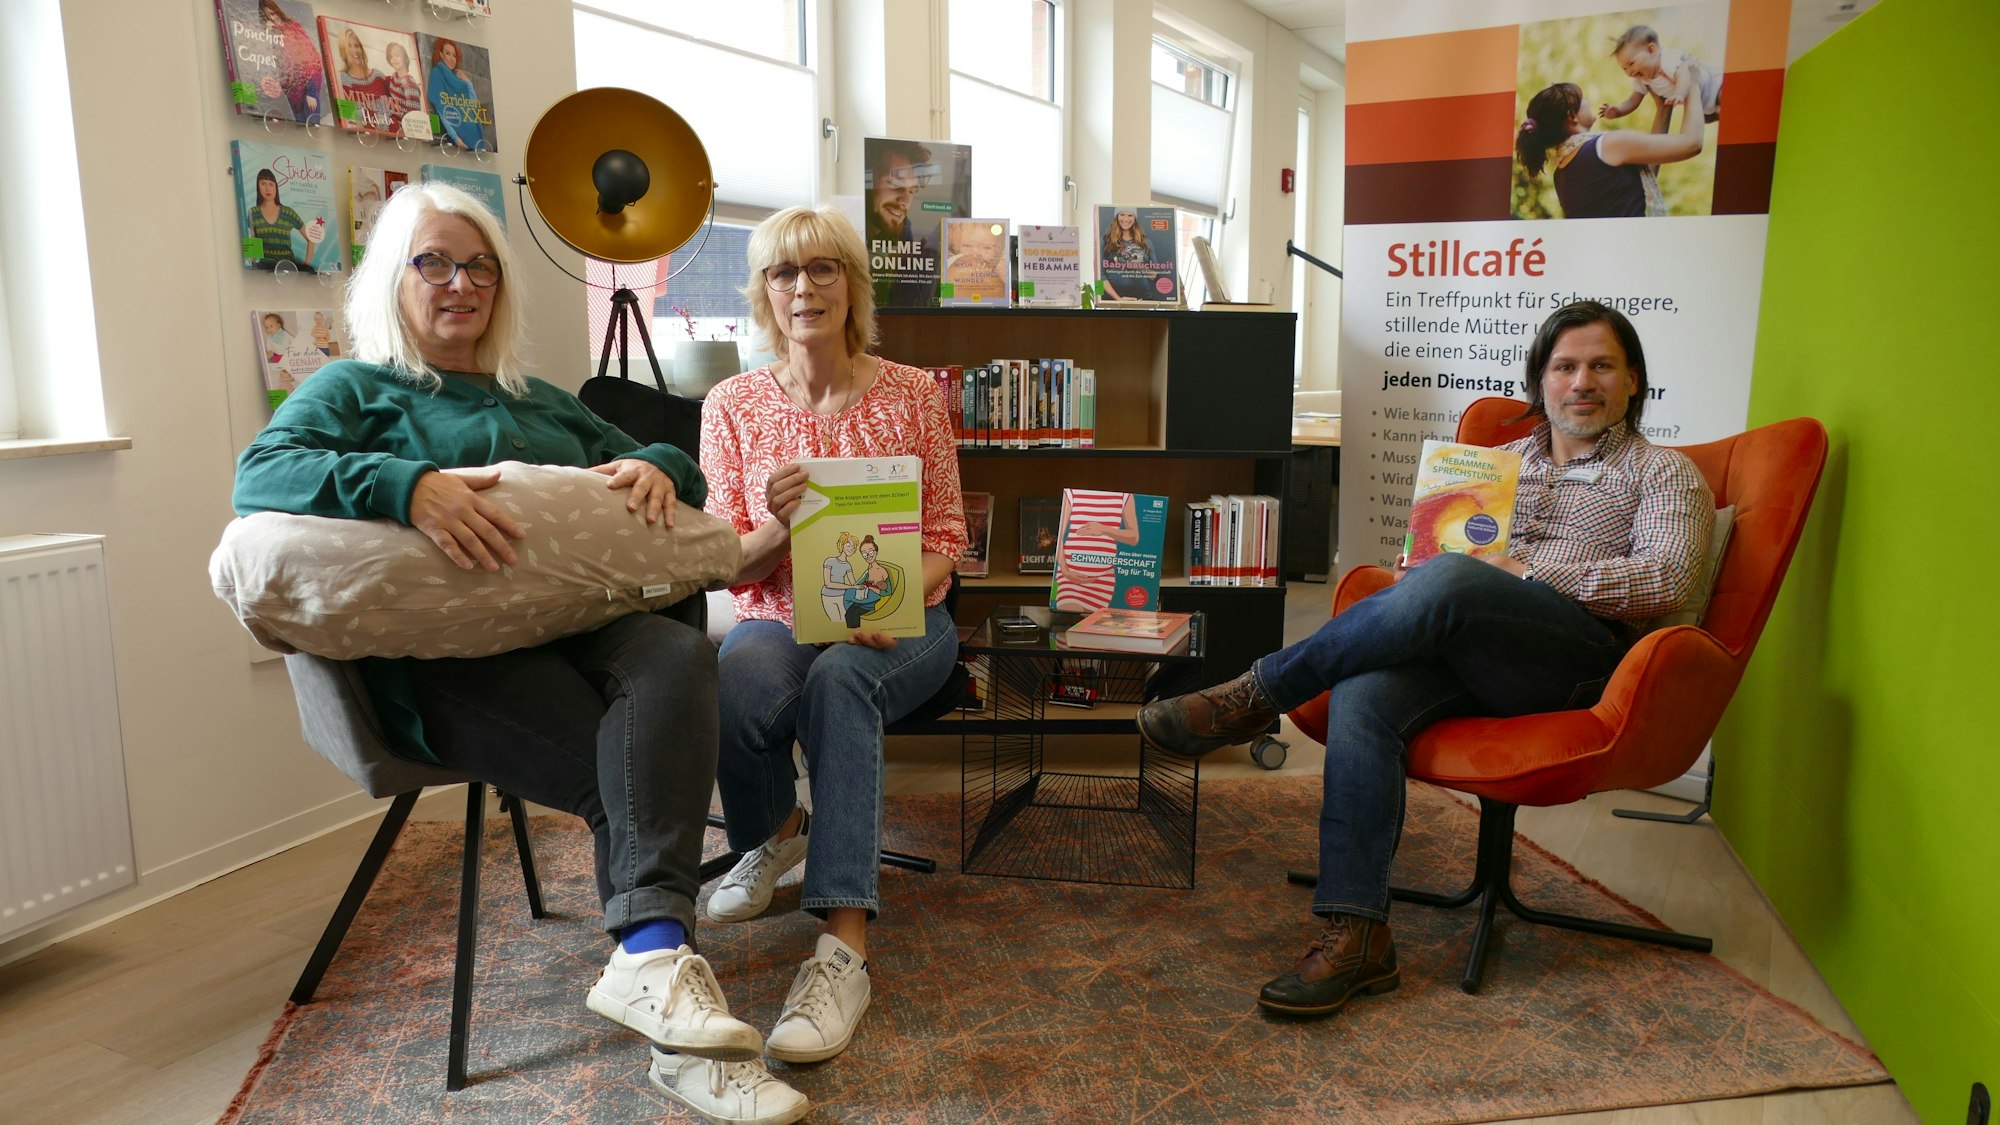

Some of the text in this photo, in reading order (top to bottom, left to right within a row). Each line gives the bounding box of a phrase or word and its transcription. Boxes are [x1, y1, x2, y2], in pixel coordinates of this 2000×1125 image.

[232, 20, 285, 47] Ponchos
[238, 45, 278, 71] Capes
[439, 91, 481, 108] Stricken
[462, 108, 492, 125] XXL
[272, 155, 326, 188] Stricken
[872, 239, 922, 255] FILME
[871, 256, 935, 272] ONLINE
[1102, 259, 1174, 270] Babybauchzeit
[1387, 237, 1546, 277] Stillcafé
[1024, 263, 1079, 271] HEBAMME
[1386, 292, 1411, 308] Ein
[1418, 292, 1512, 312] Treffpunkt
[1517, 292, 1545, 309] für
[1385, 317, 1528, 335] stillende Mütter
[1384, 342, 1410, 358] die
[1416, 343, 1463, 359] einen
[1382, 371, 1514, 396] jeden Dienstag
[1384, 408, 1410, 421] Wie
[1413, 408, 1445, 421] kann
[1383, 429, 1416, 442] Kann
[1382, 451, 1417, 464] Muss
[1464, 449, 1478, 458] DIE
[1441, 457, 1497, 471] HEBAMMEN-
[1382, 472, 1413, 486] Wird
[1433, 466, 1503, 483] SPRECHSTUNDE
[1381, 515, 1408, 528] Was
[1022, 555, 1045, 564] LICHT
[1071, 554, 1156, 568] SCHWANGERSCHAFT
[1117, 567, 1155, 579] Tag für Tag
